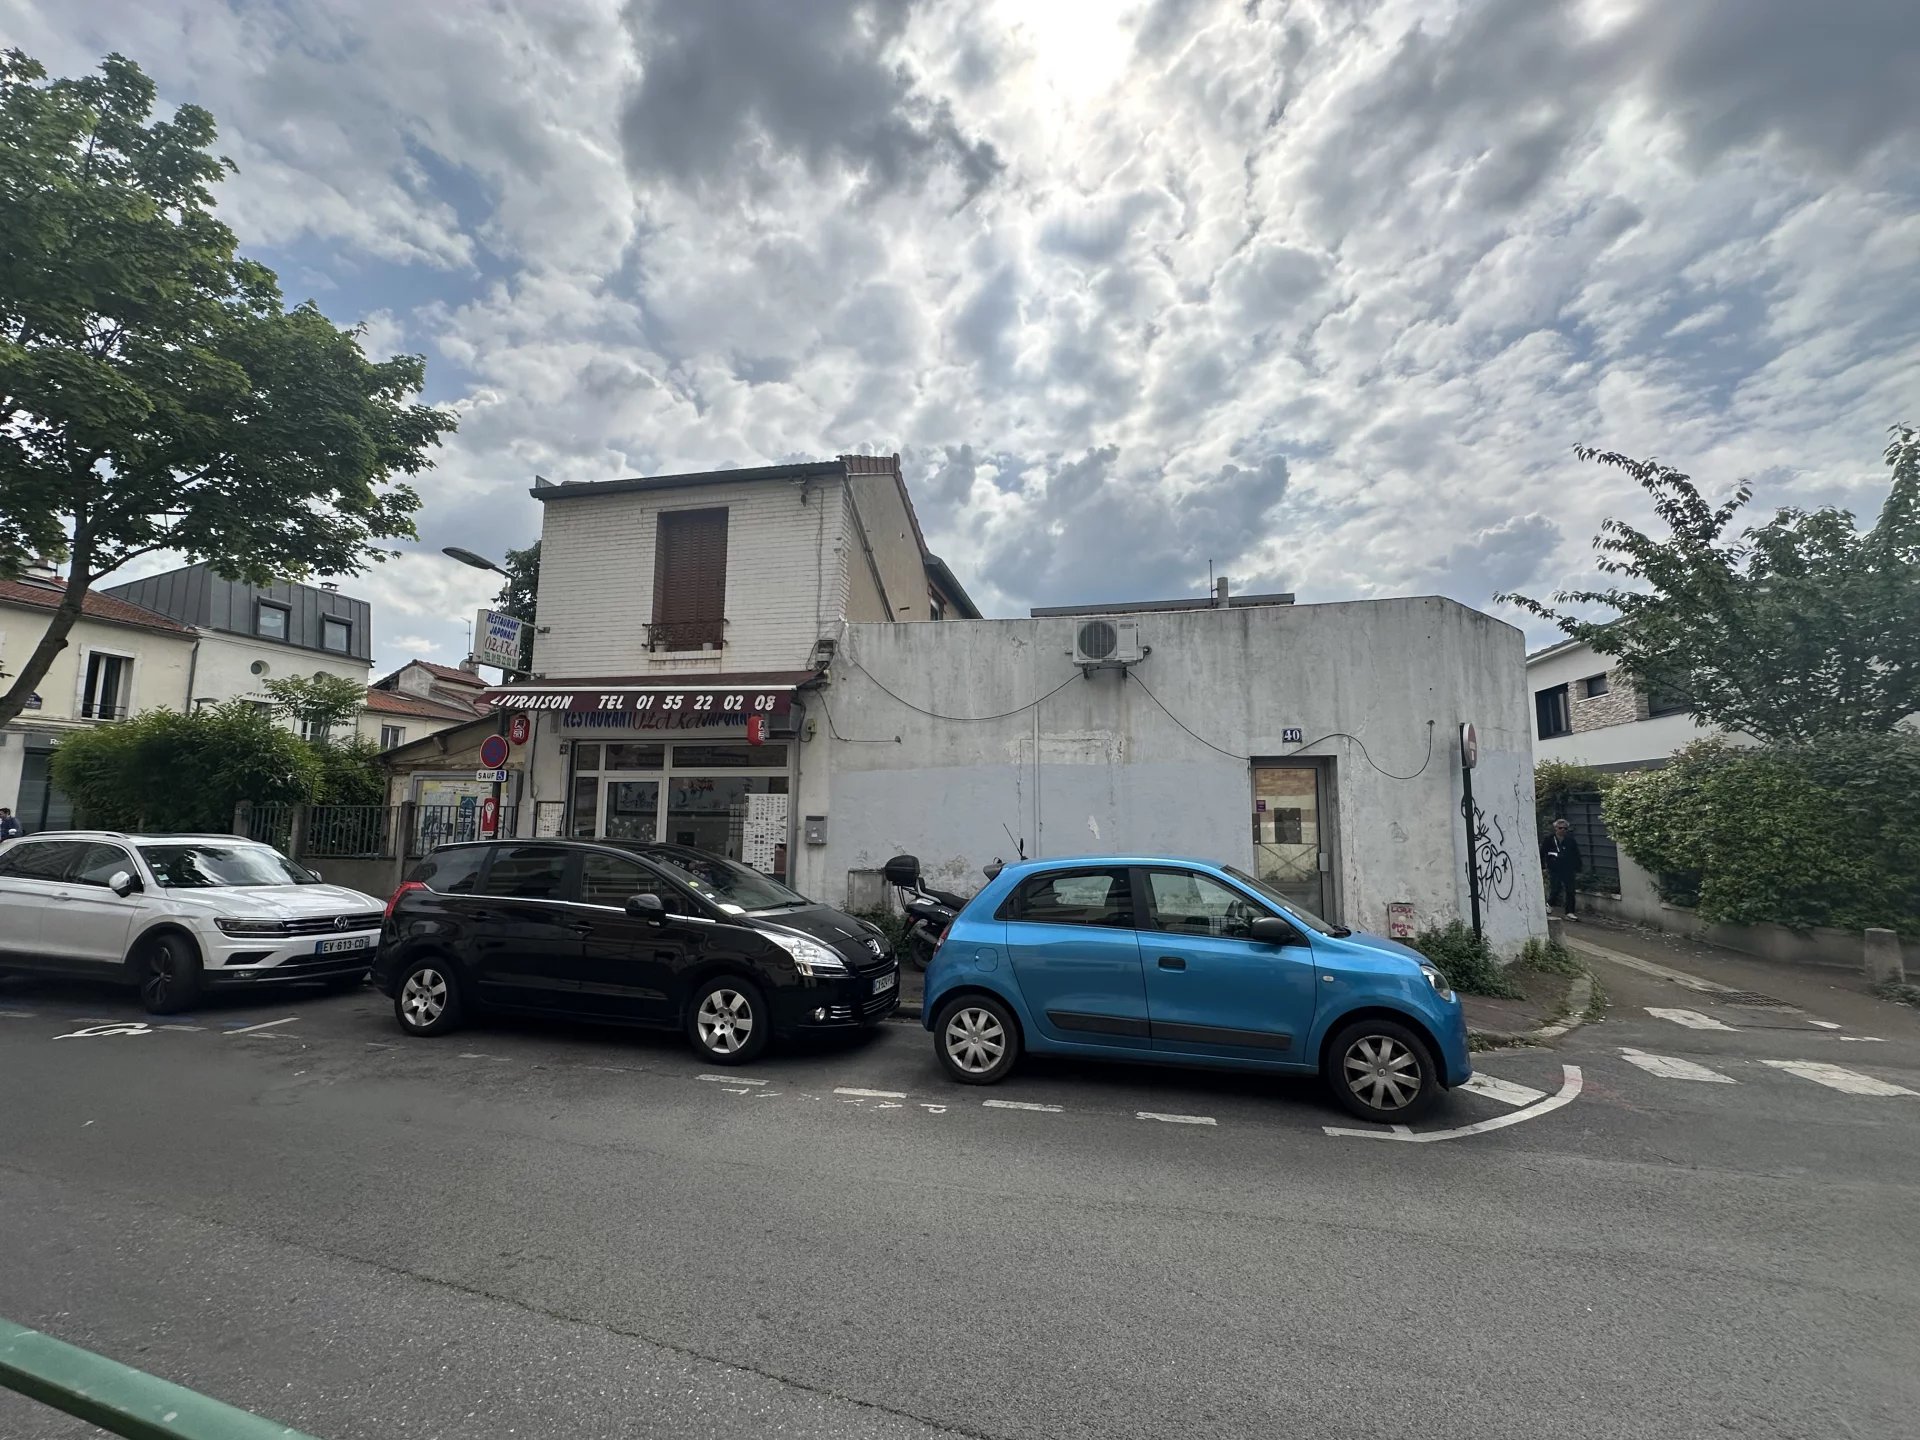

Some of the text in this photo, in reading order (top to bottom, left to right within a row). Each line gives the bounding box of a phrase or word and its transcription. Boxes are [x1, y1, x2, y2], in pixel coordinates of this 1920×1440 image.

[487, 613, 520, 631] RESTAURANT
[489, 626, 516, 641] JAPONAIS
[490, 695, 776, 711] LIVRAISON TEL 01 55 22 02 08
[563, 711, 632, 728] RESTAURANT
[1284, 730, 1300, 741] 40
